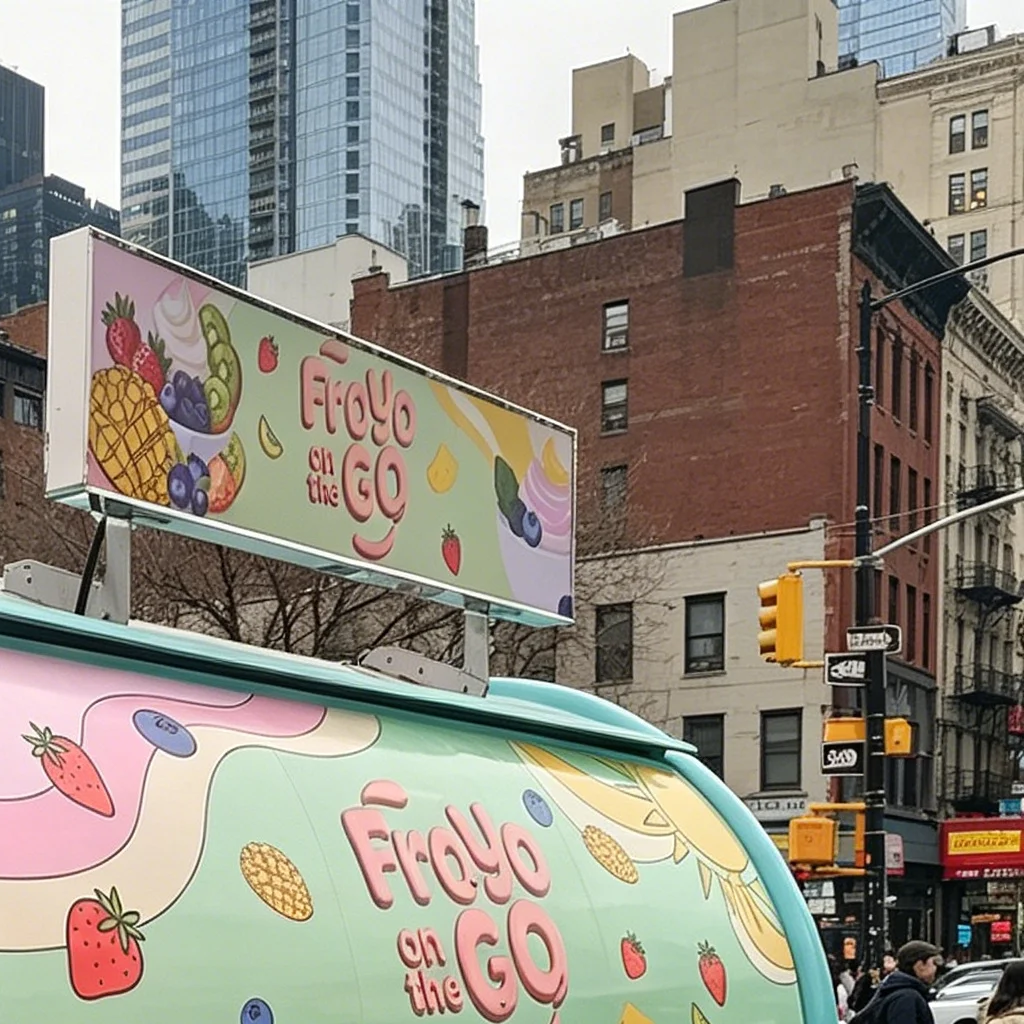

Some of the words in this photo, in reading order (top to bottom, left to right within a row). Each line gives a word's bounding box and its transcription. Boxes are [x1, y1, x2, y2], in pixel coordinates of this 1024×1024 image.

[308, 445, 334, 476] on
[342, 442, 409, 524] GO
[306, 472, 339, 508] the
[397, 927, 446, 969] on
[454, 898, 569, 1024] GO
[404, 970, 464, 1018] the
